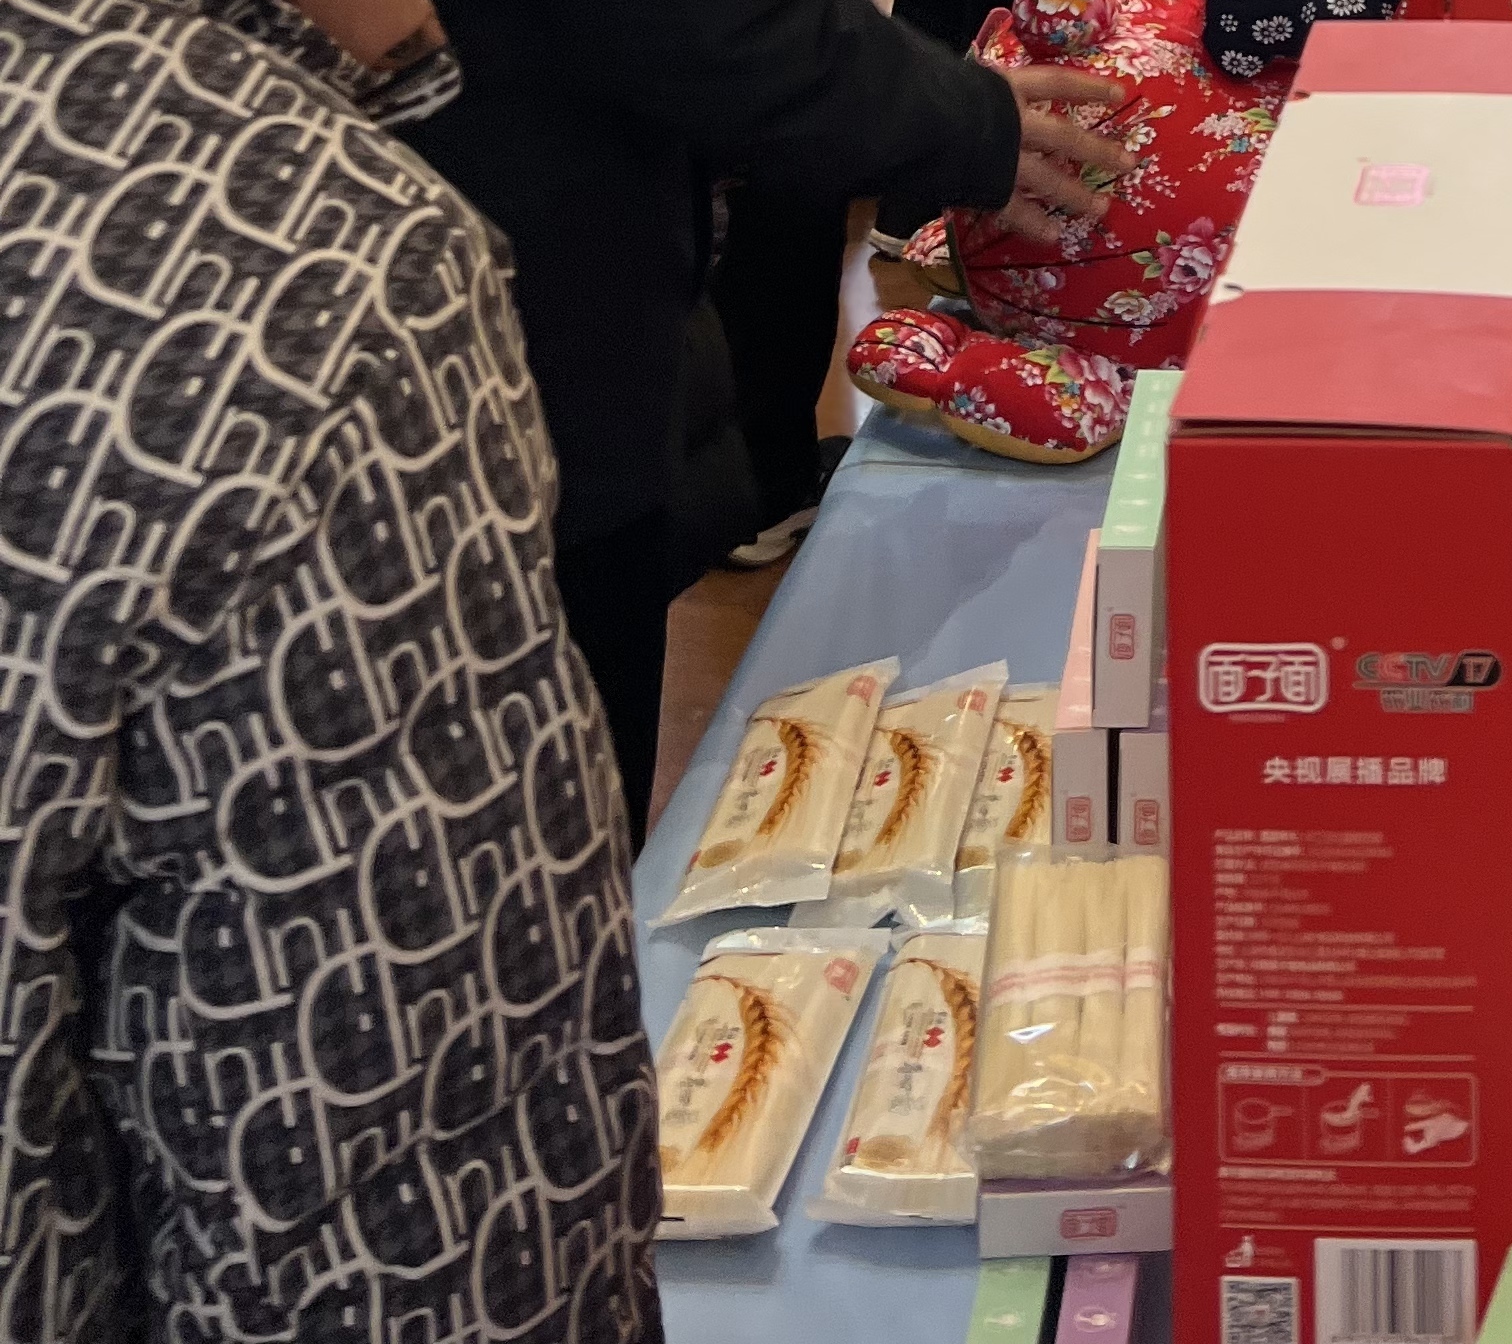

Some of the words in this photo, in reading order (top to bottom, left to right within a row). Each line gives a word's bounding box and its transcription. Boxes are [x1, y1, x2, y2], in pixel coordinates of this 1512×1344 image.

[1263, 756, 1449, 785] 央视展播品牌
